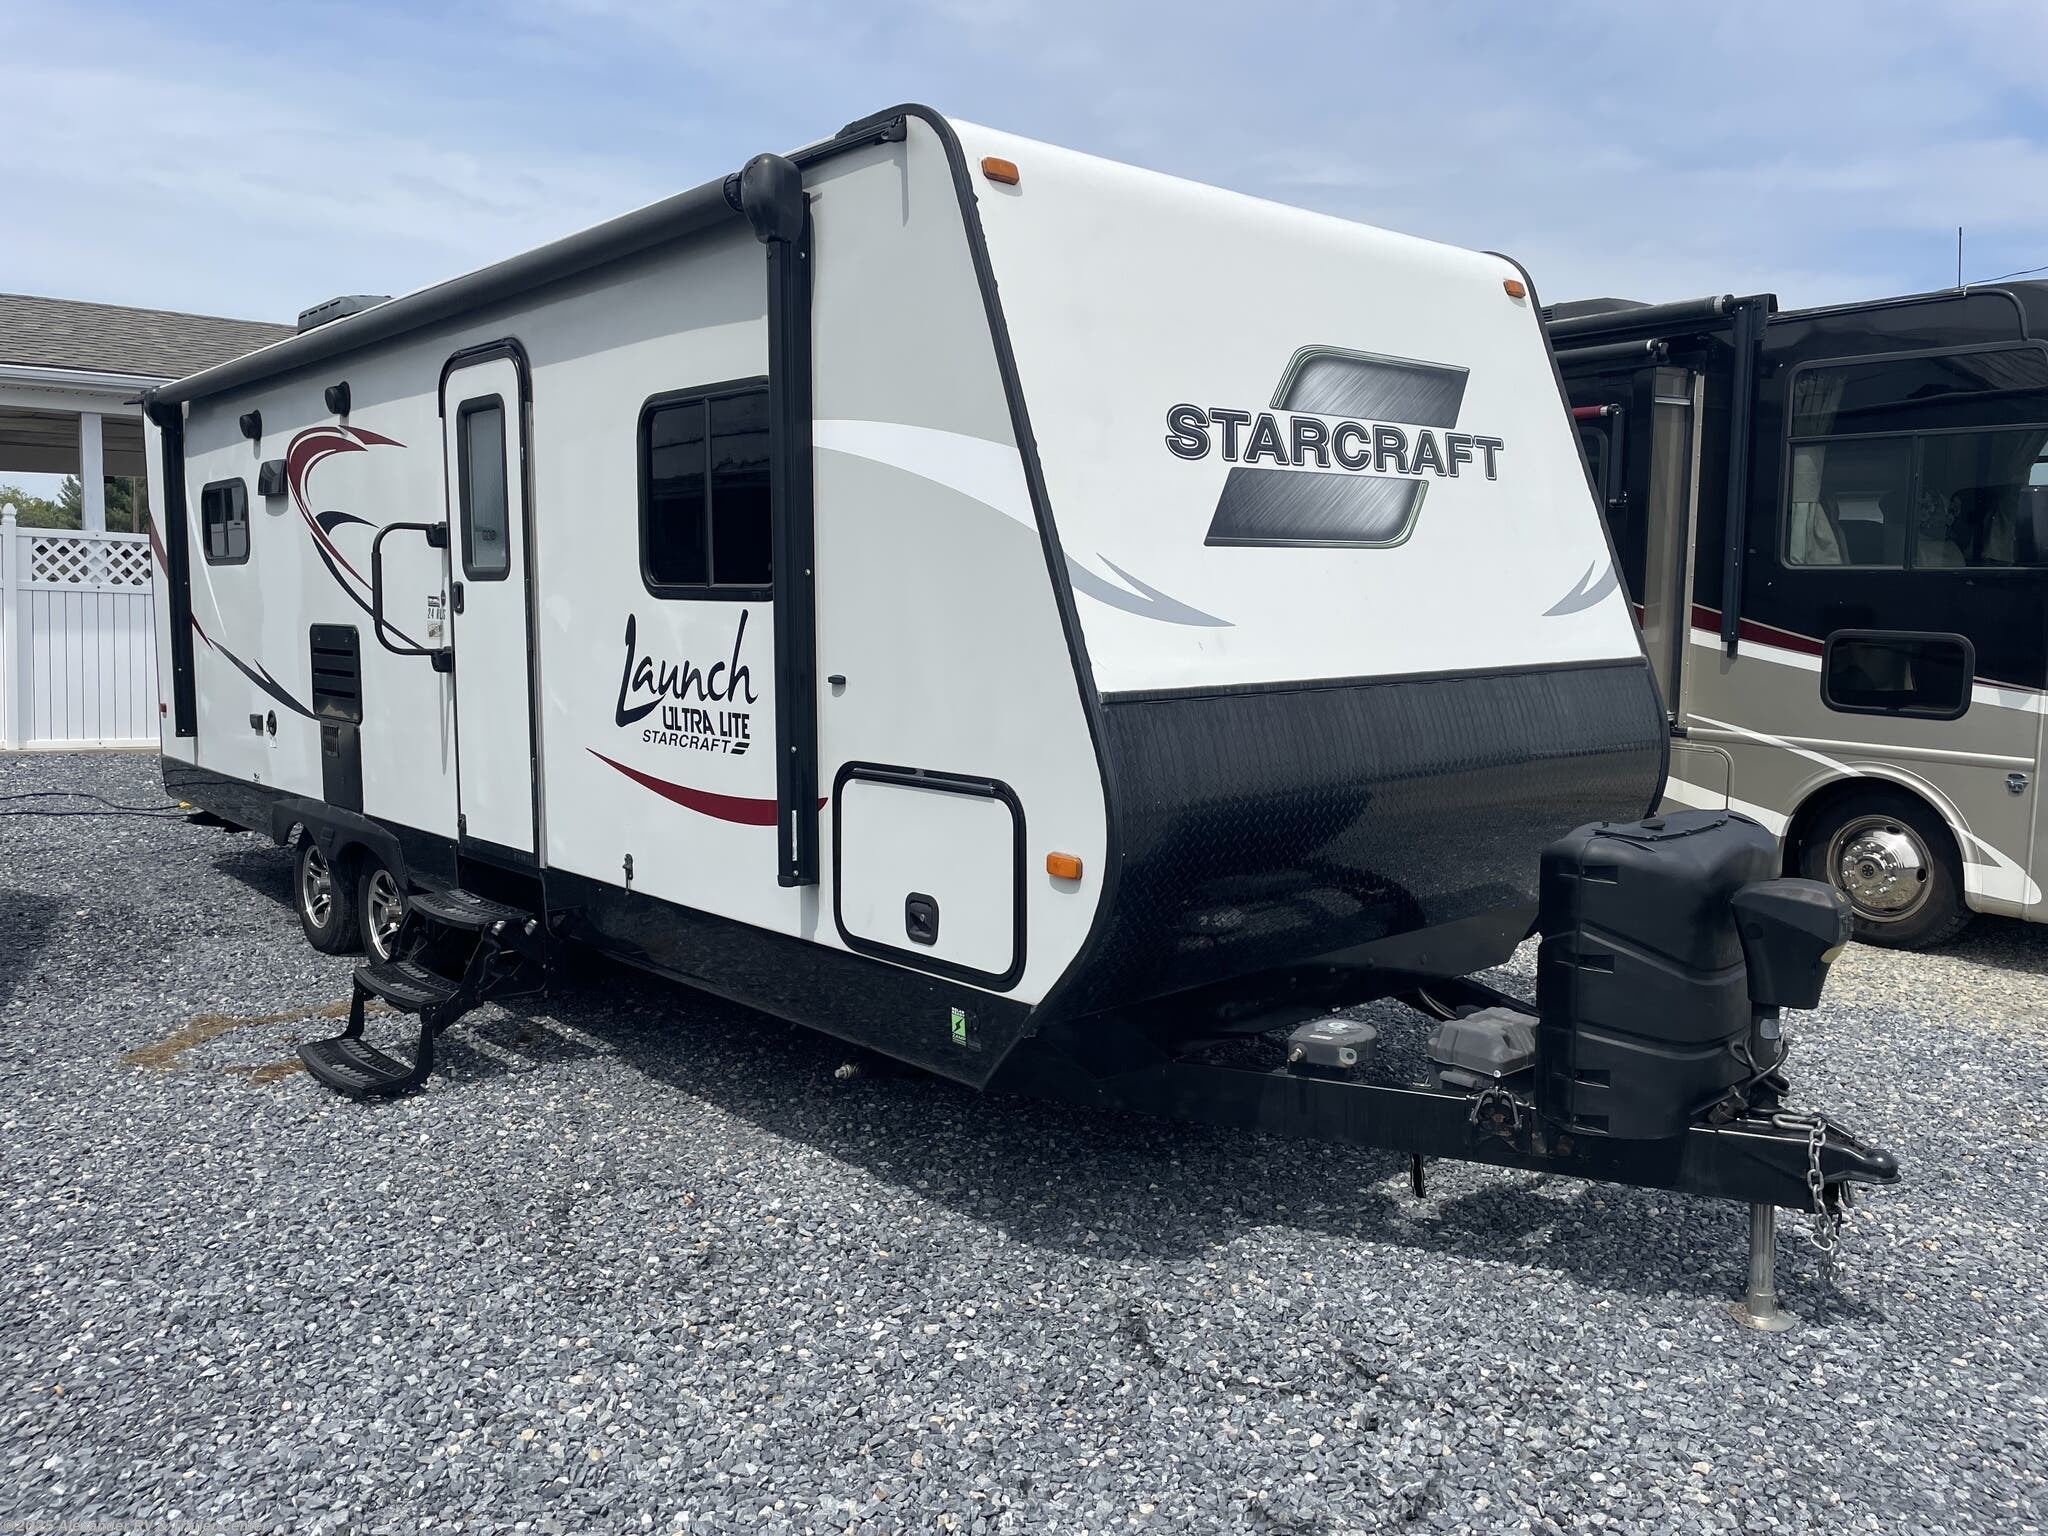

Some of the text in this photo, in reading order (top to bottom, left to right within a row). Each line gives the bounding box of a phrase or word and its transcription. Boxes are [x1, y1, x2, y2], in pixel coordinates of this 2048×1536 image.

[1165, 403, 1504, 481] STARCRAFT
[615, 609, 759, 728] Launch
[642, 729, 731, 754] STARCRAFT
[662, 705, 751, 740] ULTRA LITE
